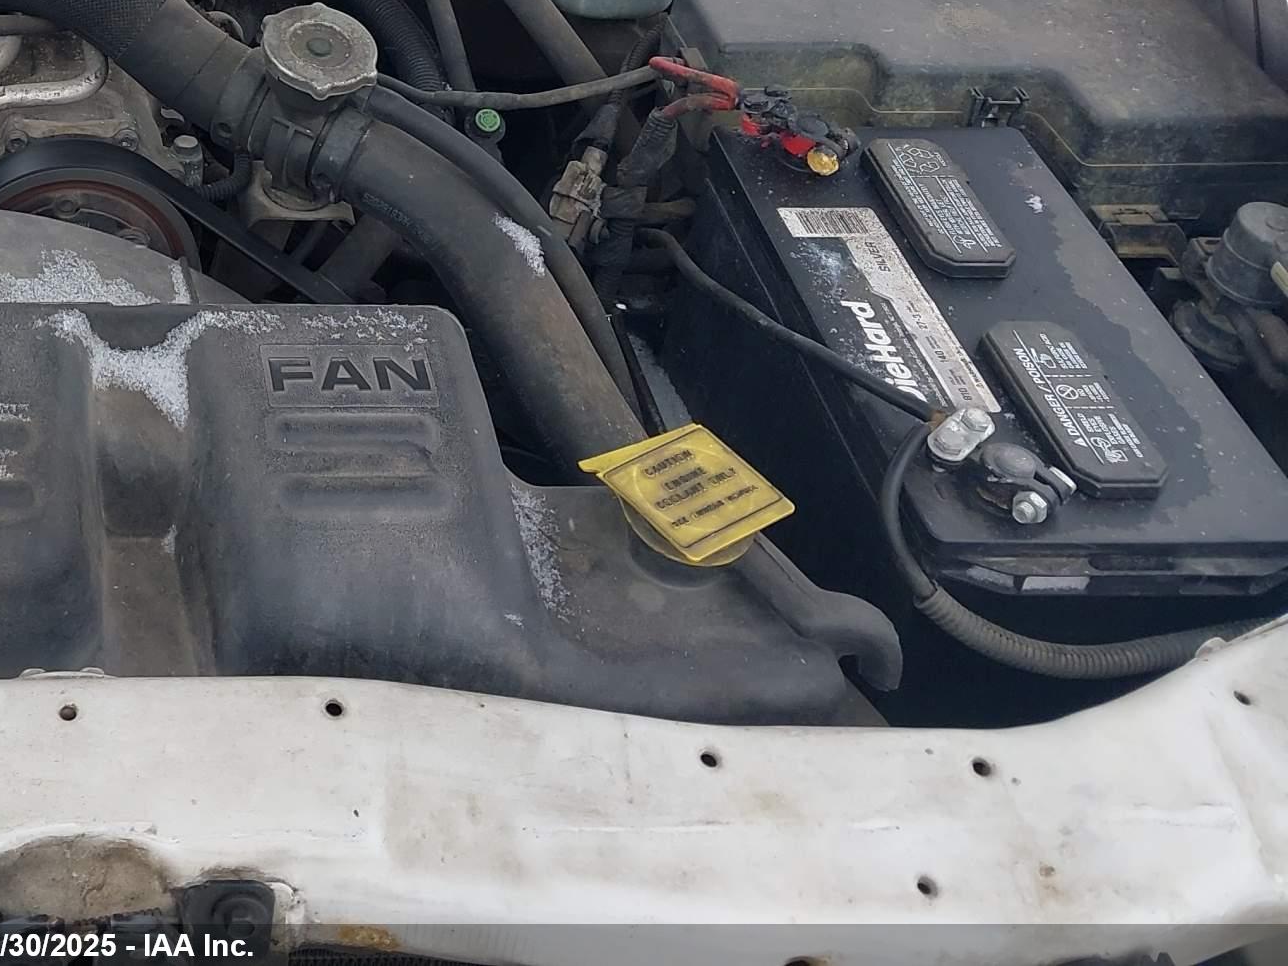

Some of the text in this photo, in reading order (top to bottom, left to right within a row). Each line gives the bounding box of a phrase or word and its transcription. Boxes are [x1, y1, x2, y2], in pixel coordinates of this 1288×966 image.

[864, 241, 891, 272] SILVER
[267, 356, 434, 393] FAN
[1013, 348, 1045, 384] POISON
[1044, 394, 1080, 436] DANGER
[643, 450, 695, 477] CAUTION
